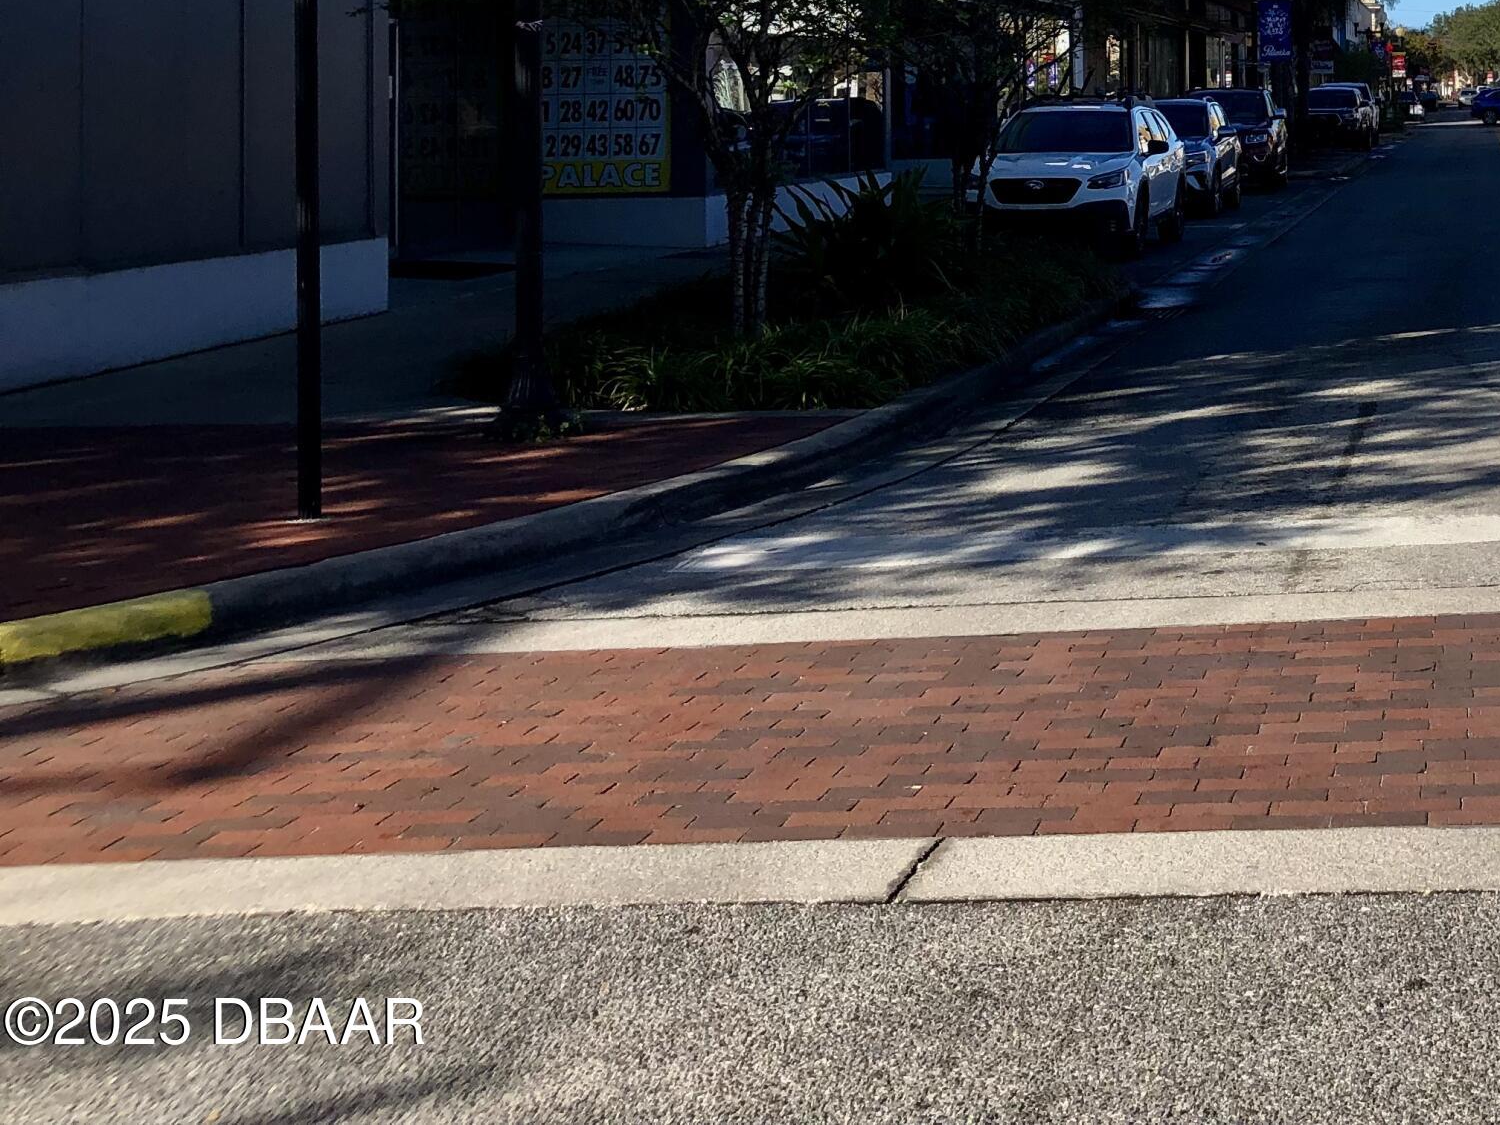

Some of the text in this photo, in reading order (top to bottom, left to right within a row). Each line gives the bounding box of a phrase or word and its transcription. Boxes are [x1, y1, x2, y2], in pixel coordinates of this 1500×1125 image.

[546, 32, 556, 54] 5
[561, 32, 582, 54] 24
[586, 31, 606, 54] 37
[561, 66, 582, 88] 27
[613, 65, 635, 88] 48
[639, 65, 662, 87] 75
[560, 100, 582, 123] 28
[586, 100, 608, 122] 42
[614, 99, 635, 121] 60
[639, 99, 661, 121] 70
[546, 133, 661, 157] 2 29 43 58 67
[543, 162, 661, 188] PALACE
